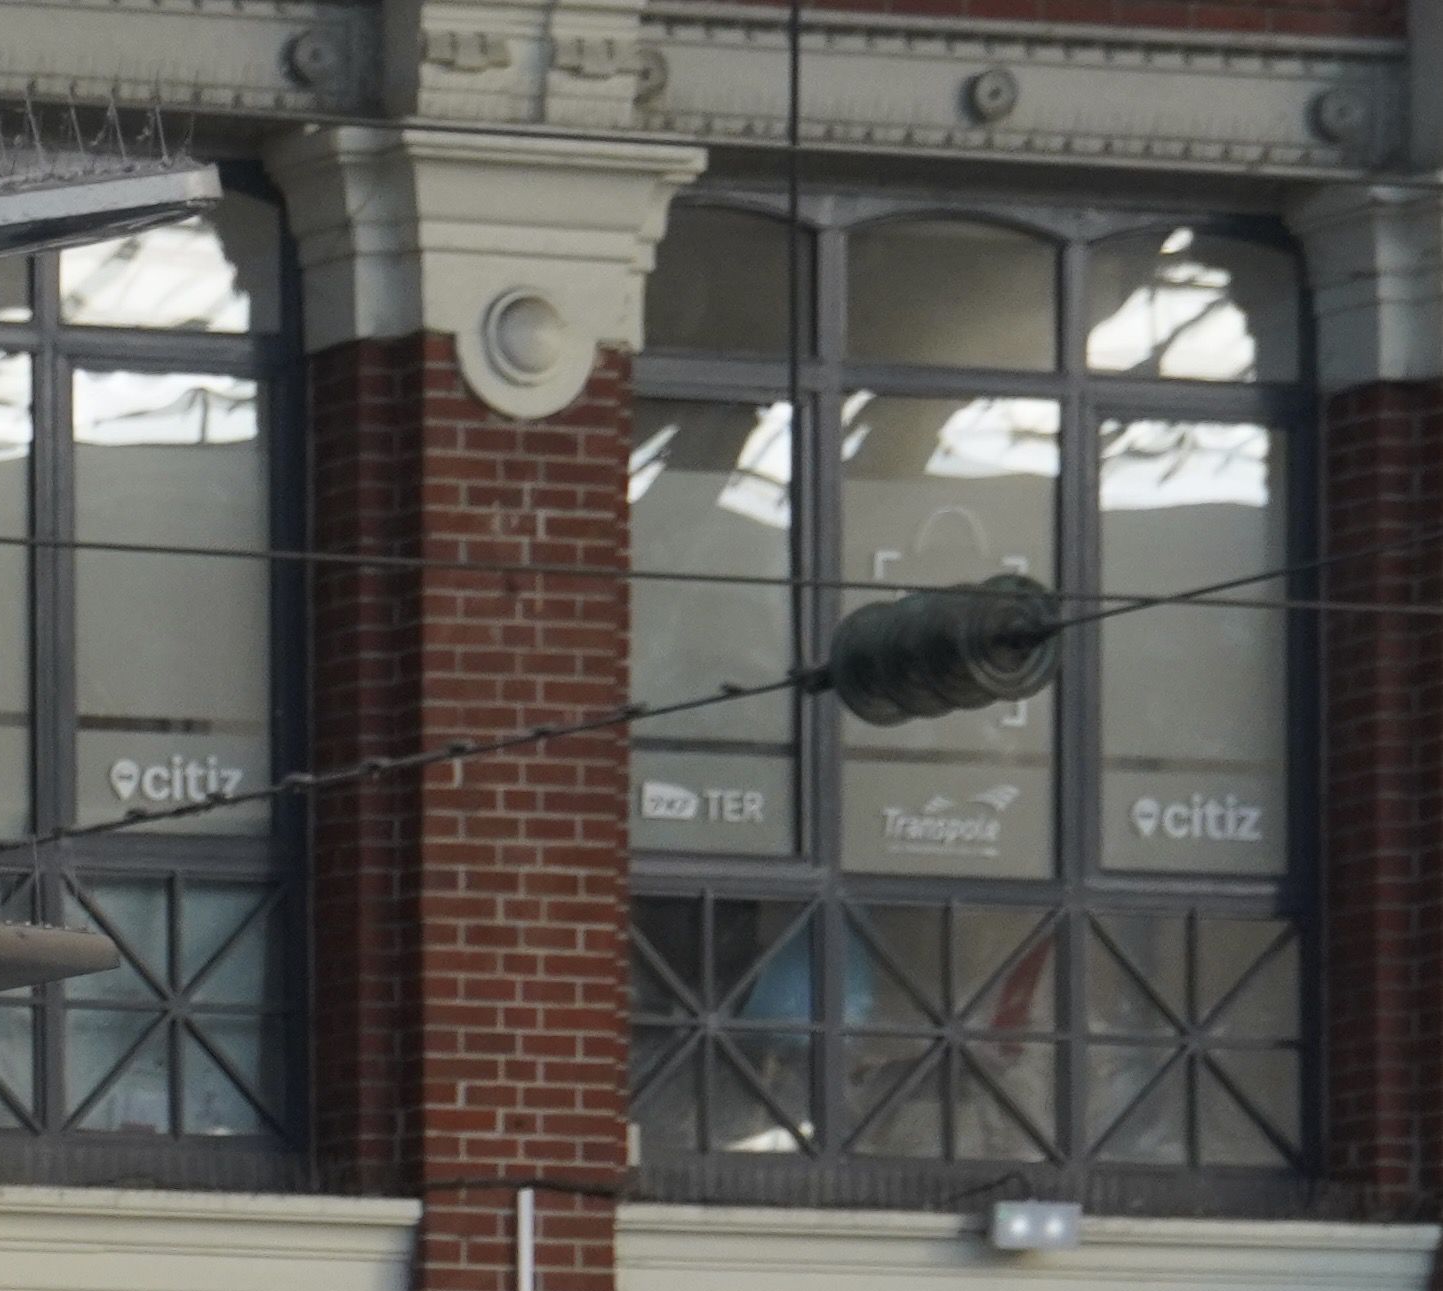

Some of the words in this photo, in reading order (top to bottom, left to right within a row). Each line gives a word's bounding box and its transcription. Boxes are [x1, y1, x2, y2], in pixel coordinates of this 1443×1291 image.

[141, 753, 243, 802] citiz
[704, 788, 763, 823] TER
[1162, 794, 1263, 842] citiz
